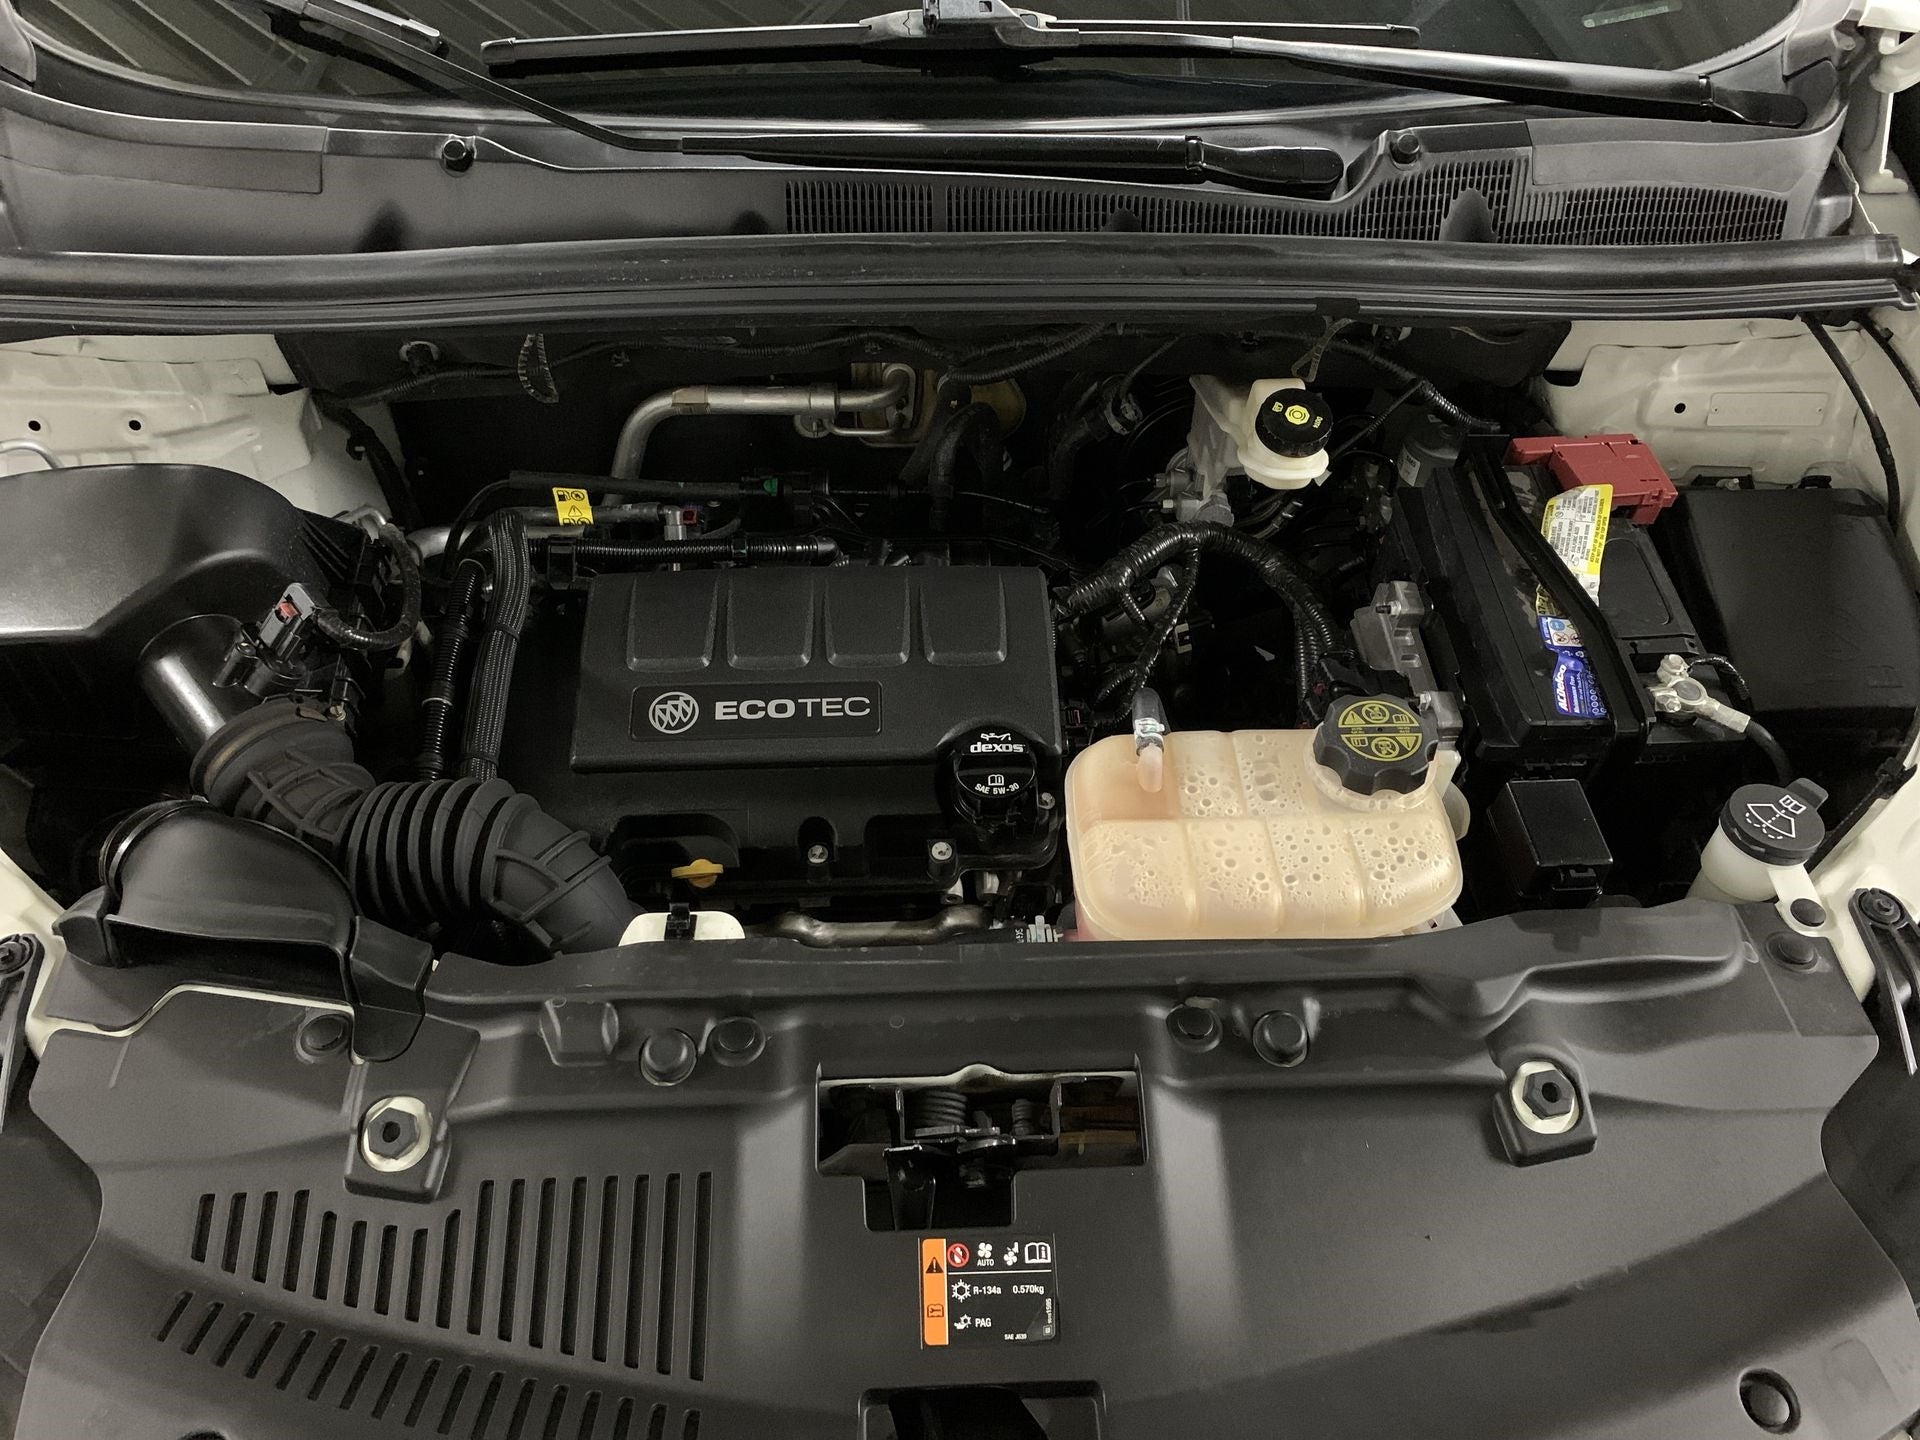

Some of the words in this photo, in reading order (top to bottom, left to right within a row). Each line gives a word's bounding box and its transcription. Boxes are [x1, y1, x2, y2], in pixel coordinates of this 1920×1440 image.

[1555, 664, 1569, 712] ACDelco
[715, 697, 871, 720] ECOTEC
[970, 742, 1024, 753] dexos
[974, 783, 991, 794] SAE
[993, 782, 1020, 795] 5W-30
[973, 1286, 1001, 1295] R-134a
[1012, 1285, 1045, 1295] 0.570kg
[975, 1318, 992, 1328] PAG
